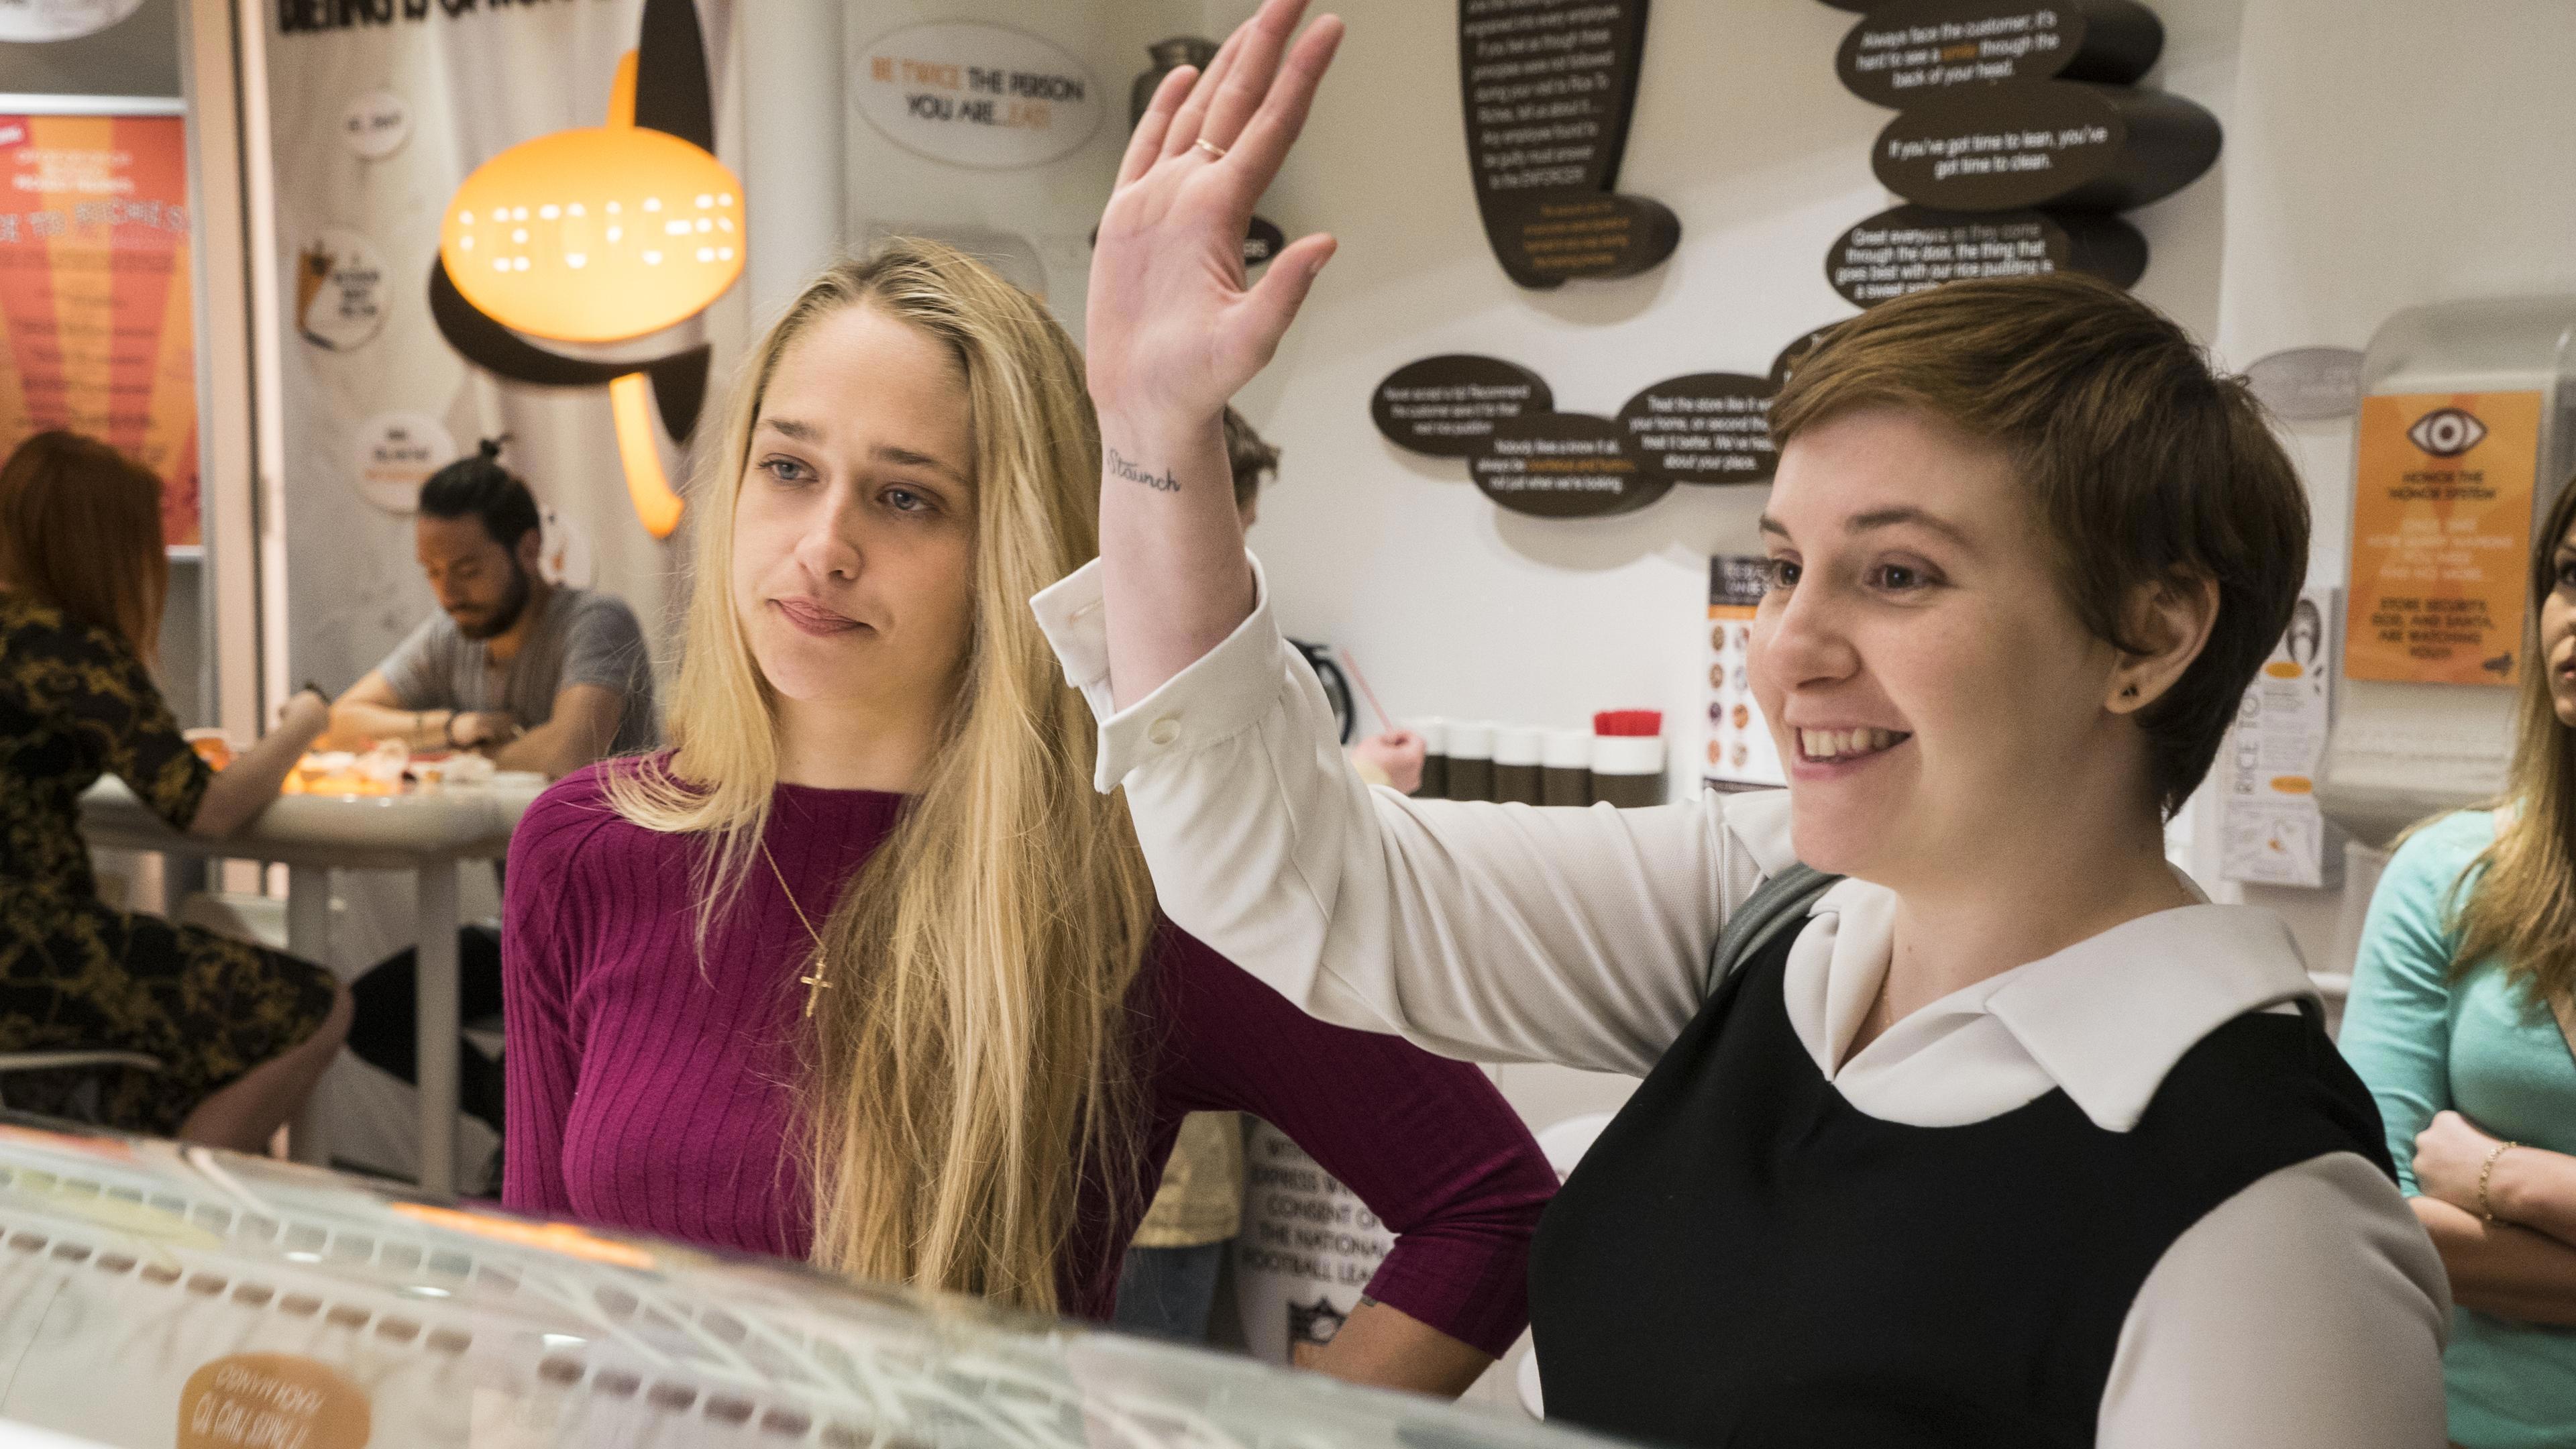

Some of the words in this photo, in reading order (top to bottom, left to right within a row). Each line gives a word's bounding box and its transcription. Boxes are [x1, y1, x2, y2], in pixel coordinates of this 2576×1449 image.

[1860, 30, 1907, 51] Always
[1909, 25, 1938, 44] face
[1940, 21, 1962, 40] the
[2035, 9, 2057, 29] it's
[1855, 52, 1886, 72] hard
[1889, 51, 1902, 68] to
[1904, 50, 1929, 66] see
[1930, 48, 1940, 63] a
[1941, 42, 1977, 61] smile
[1979, 35, 2033, 58] through
[2035, 33, 2059, 51] the
[871, 56, 893, 83] BE
[902, 58, 961, 91] TWICE
[968, 65, 1004, 95] THE
[1010, 71, 1085, 103] PERSON
[1891, 70, 1925, 90] back
[1927, 65, 1945, 84] of
[1944, 66, 1975, 88] your
[906, 93, 953, 121] YOU
[1888, 139, 1901, 158] If
[1900, 137, 1945, 162] you've
[1947, 136, 1971, 158] got
[1972, 133, 2003, 152] time
[2004, 131, 2020, 150] to
[2057, 123, 2108, 151] you've
[1933, 160, 1958, 181] got
[1960, 156, 1991, 174] time
[1992, 154, 2008, 172] to
[2009, 152, 2053, 172] clean.
[1851, 227, 1888, 246] Greet
[1889, 229, 1948, 247] everyone
[1969, 223, 1998, 244] they
[2000, 223, 2041, 239] come
[1845, 246, 1894, 267] through
[1896, 245, 1920, 262] the
[1955, 242, 1978, 260] the
[1980, 240, 2015, 262] thing
[2017, 238, 2046, 258] that
[1835, 268, 1869, 286] goes
[1870, 265, 1900, 282] best
[1900, 262, 1927, 280] with
[1929, 263, 1953, 278] our
[1953, 261, 1980, 278] rice
[1980, 258, 2039, 277] pudding
[1854, 284, 1866, 299] a
[1866, 282, 1904, 299] sweet
[1648, 394, 1674, 411] Treat
[1674, 394, 1695, 411] the
[1695, 396, 1723, 411] store
[1725, 394, 1745, 412] like
[1746, 395, 1756, 411] it
[1629, 417, 1654, 435] your
[1707, 415, 1748, 431] second
[1494, 438, 1532, 458] Nobody
[1642, 435, 1666, 451] treat
[1108, 447, 1181, 492] Staunch
[1477, 457, 1509, 473] always
[1662, 453, 1697, 470] about
[1697, 454, 1723, 474] your
[2458, 470, 2483, 483] THE
[2446, 488, 2496, 500] SYSTEM
[2239, 694, 2261, 730] TO
[2235, 741, 2259, 795] RICE
[1250, 1163, 1318, 1193] EXPRESS
[1266, 1192, 1352, 1225] CONSENT
[1257, 1220, 1291, 1246] THE
[1295, 1228, 1387, 1259] NATIONAL
[1241, 1244, 1333, 1283] FOOTBALL
